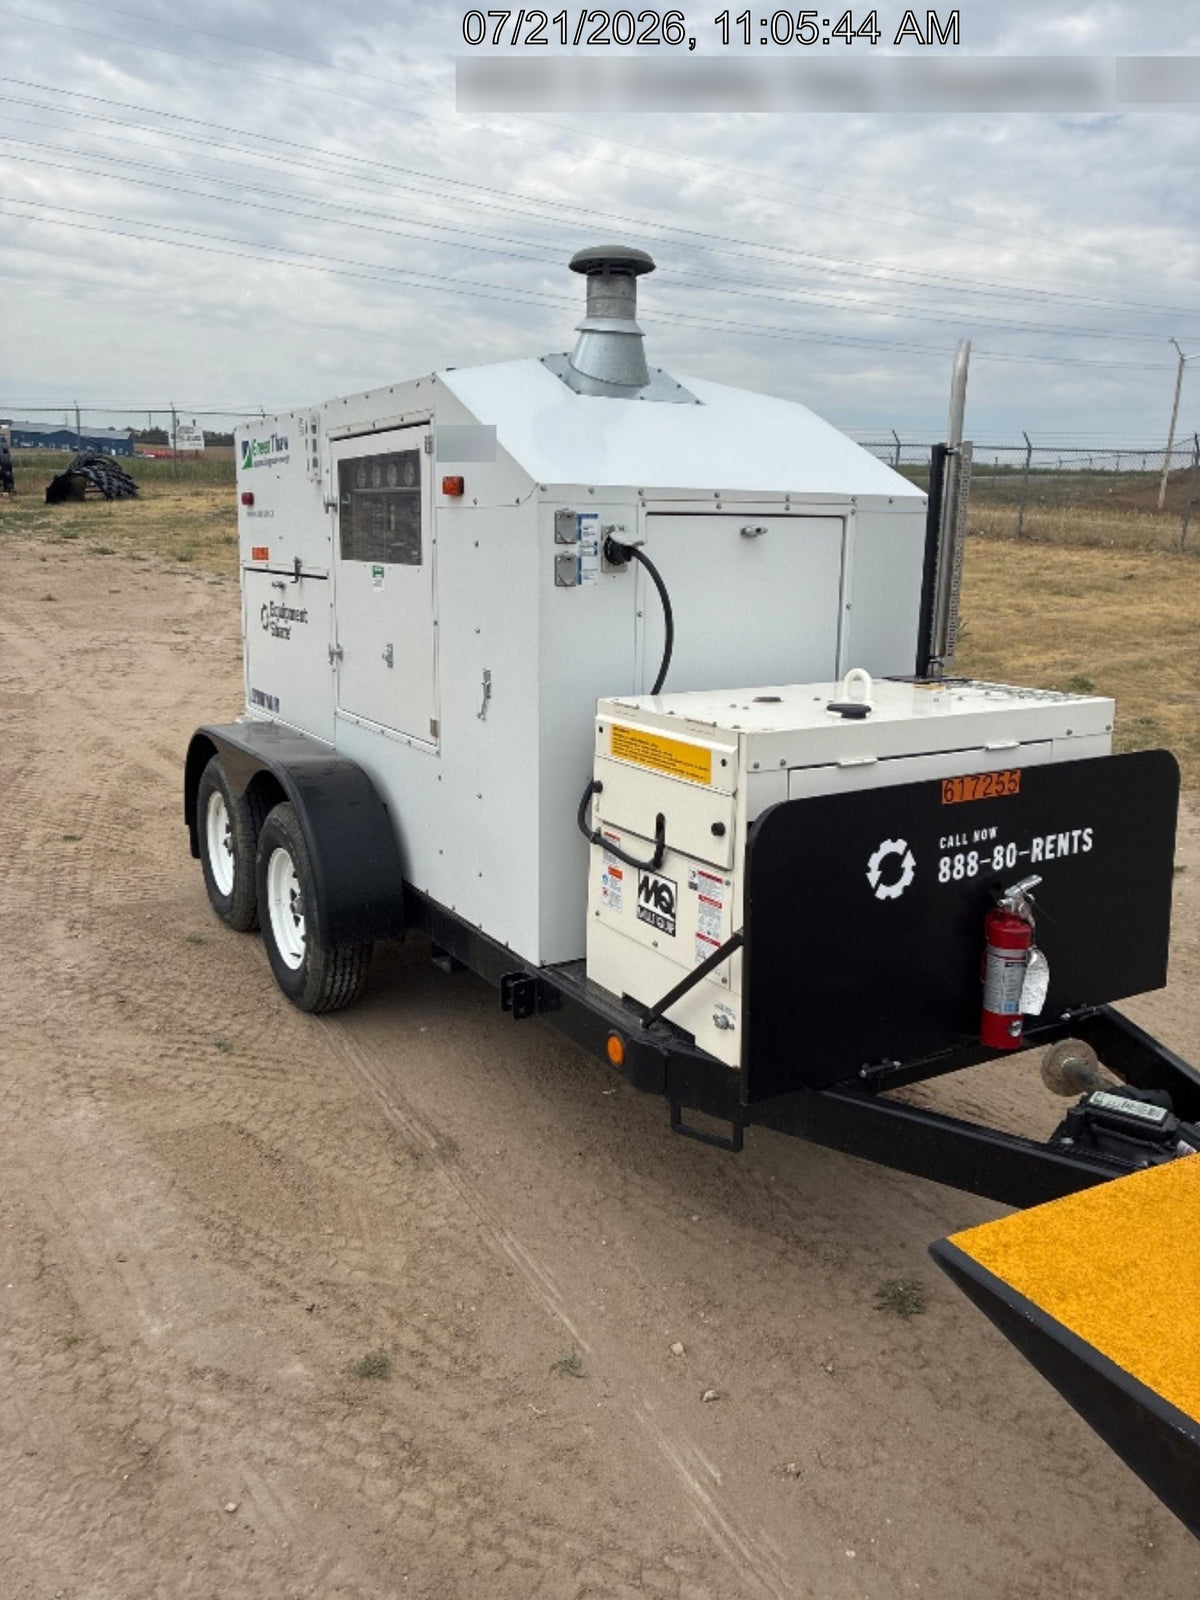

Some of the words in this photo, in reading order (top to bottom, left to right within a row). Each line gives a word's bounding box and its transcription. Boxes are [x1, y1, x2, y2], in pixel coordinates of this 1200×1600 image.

[943, 770, 1019, 803] 617255
[939, 833, 969, 849] CALL
[973, 826, 999, 843] NOW
[938, 828, 1094, 883] 888-80-RENTS
